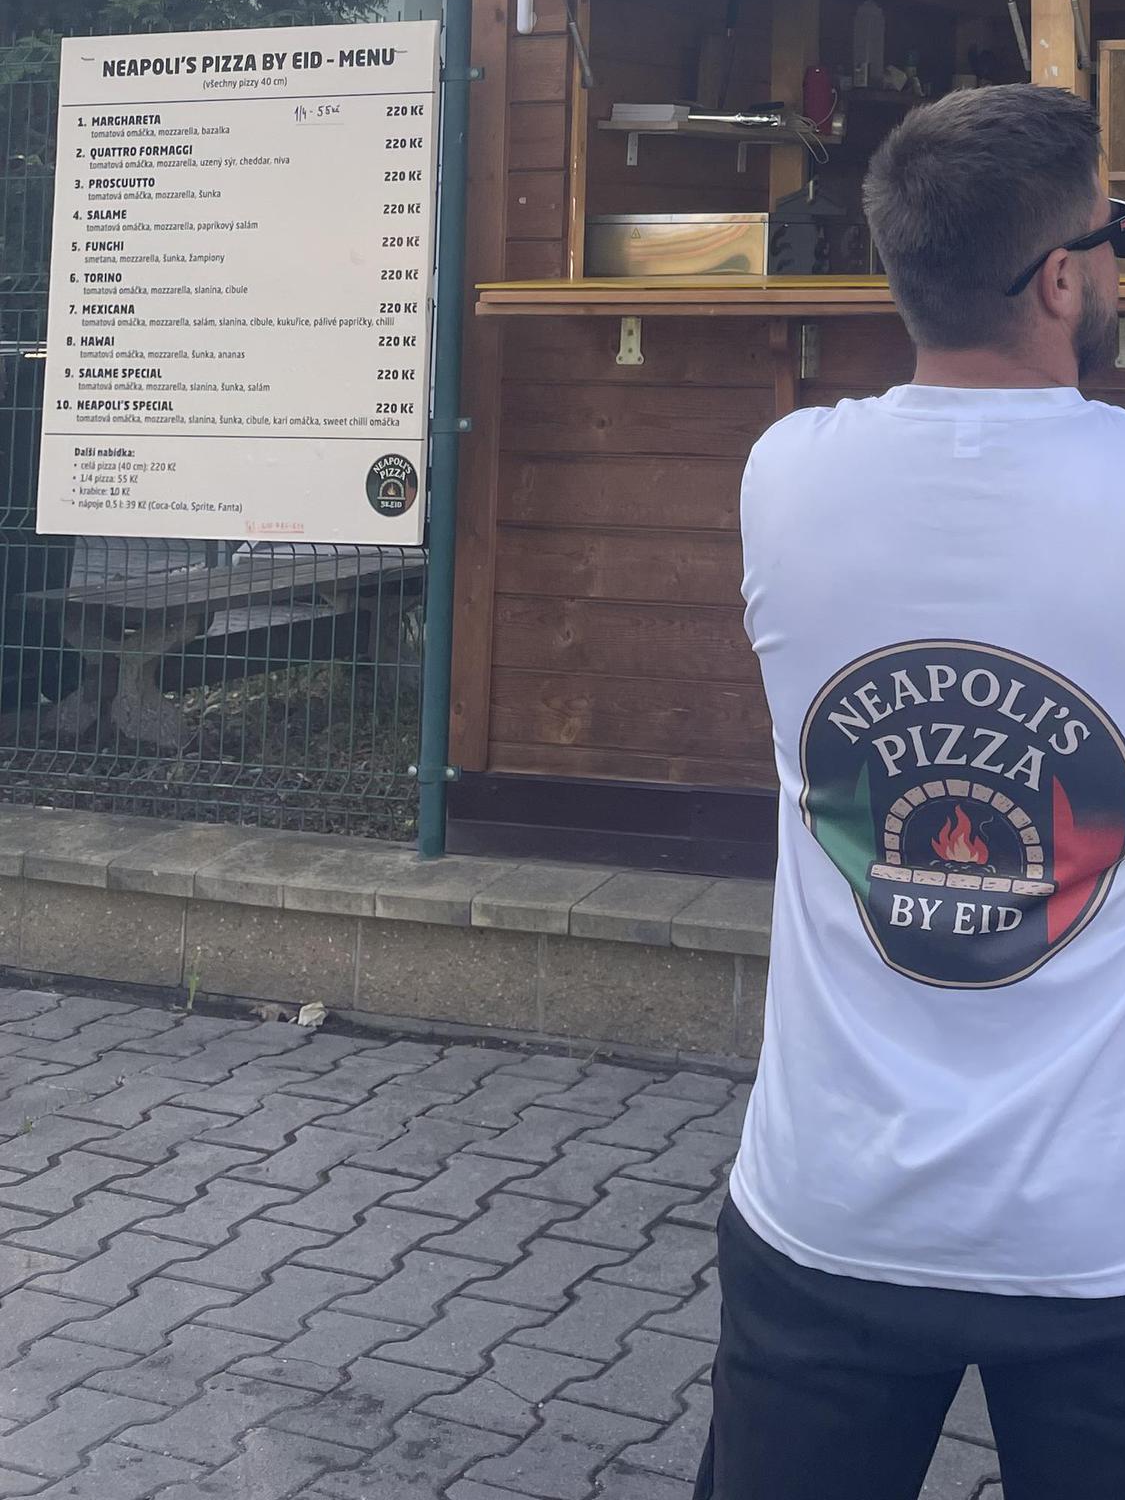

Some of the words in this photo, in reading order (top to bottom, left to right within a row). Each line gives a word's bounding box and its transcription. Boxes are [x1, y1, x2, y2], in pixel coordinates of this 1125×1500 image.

[103, 57, 197, 77] NEAPOLI'S
[202, 54, 257, 73] PIZZA
[262, 53, 287, 70] BY
[292, 51, 322, 69] EID
[339, 48, 395, 67] MENU
[203, 79, 237, 90] (všechny
[239, 79, 259, 89] pizzy
[261, 77, 271, 86] 40
[274, 77, 287, 86] cm)
[387, 106, 407, 116] 220
[411, 105, 423, 115] Kč
[78, 118, 87, 127] 1.
[92, 115, 160, 126] MARGHARETA
[91, 130, 124, 138] tomatová
[201, 126, 230, 134] bazalka
[386, 139, 406, 148] 220
[410, 137, 422, 148] Kč
[76, 149, 85, 157] 2.
[90, 147, 137, 158] QUATTRO
[139, 145, 192, 156] FORMAGGI
[200, 158, 222, 167] uzený
[384, 171, 405, 181] 220
[409, 170, 422, 181] Kč
[75, 179, 83, 188] 3.
[89, 178, 155, 188] PROSCUUTTO
[199, 190, 221, 198] šunka
[383, 204, 404, 214] 220
[408, 203, 421, 213] Kč
[73, 211, 82, 220] 4.
[87, 210, 127, 219] SALAME
[87, 224, 120, 232] tomatová
[197, 221, 234, 231] paprikový
[236, 221, 258, 229] salám
[72, 242, 80, 251] 5.
[85, 242, 124, 251] FUNGHI
[382, 237, 403, 247] 220
[406, 236, 420, 247] Kč
[85, 256, 117, 264] smetana,
[189, 254, 225, 263] žampiony
[70, 274, 79, 283] 6.
[84, 273, 122, 282] TORINO
[381, 270, 402, 280] 220
[405, 269, 418, 279] Kč
[84, 287, 117, 295] tomatová
[226, 286, 248, 294] cibule
[69, 305, 77, 314] 7.
[83, 305, 135, 314] MEXICANA
[380, 303, 401, 313] 220
[404, 302, 417, 313] Kč
[82, 318, 115, 326] tomatová
[314, 318, 337, 326] pálivé
[67, 337, 76, 346] 8.
[81, 337, 114, 346] HAWAI
[378, 337, 400, 346] 220
[403, 336, 416, 346] Kč
[80, 350, 113, 358] tomatová
[65, 369, 74, 378] 9.
[79, 369, 118, 378] SALAME
[122, 369, 162, 378] SPECIAL
[377, 370, 398, 380] 220
[402, 369, 415, 380] Kč
[79, 382, 112, 390] tomatová
[56, 401, 72, 410] 10.
[77, 400, 130, 410] NEAPOLI'S
[133, 401, 173, 411] SPECIAL
[376, 403, 397, 413] 220
[400, 403, 413, 413] Kč
[370, 418, 399, 427] omáčka
[75, 448, 95, 456] Další
[150, 463, 165, 471] 220
[380, 468, 406, 480] PIZZA
[125, 501, 136, 509] 39
[218, 503, 242, 513] Fanta)
[827, 663, 1091, 756] NEAPOLI'S
[872, 723, 1045, 792] PIZZA
[890, 894, 942, 931] BY
[953, 902, 1023, 935] EID
